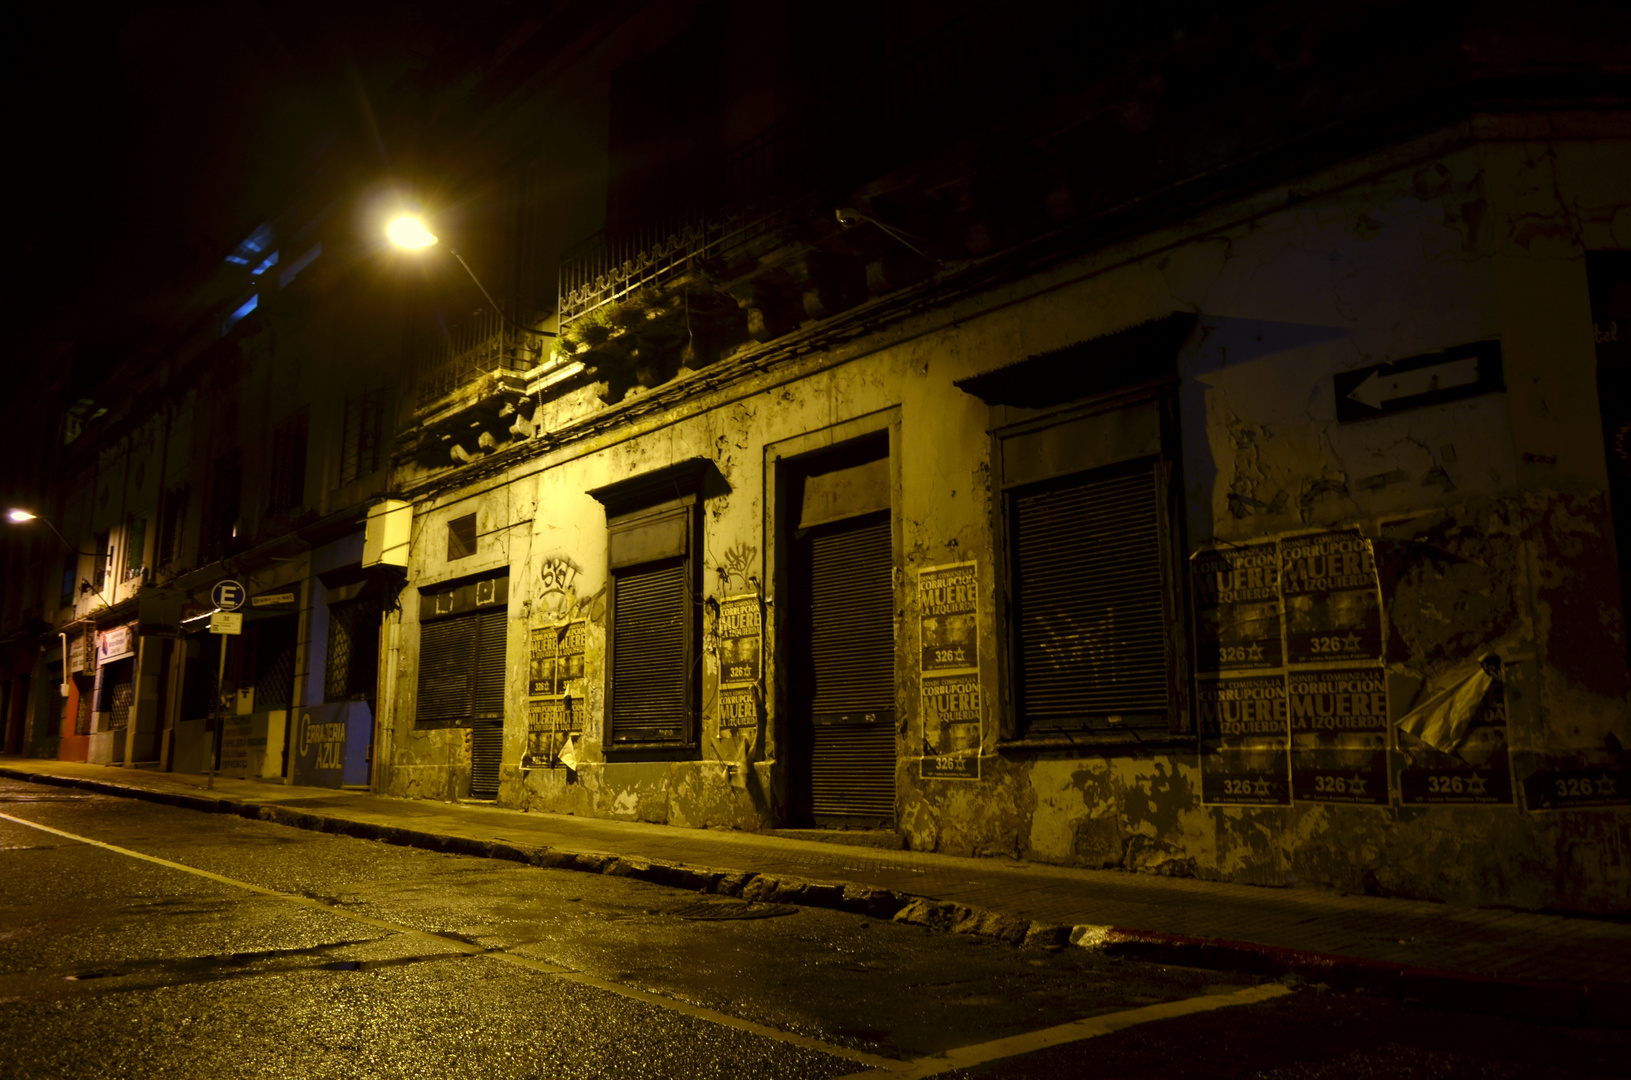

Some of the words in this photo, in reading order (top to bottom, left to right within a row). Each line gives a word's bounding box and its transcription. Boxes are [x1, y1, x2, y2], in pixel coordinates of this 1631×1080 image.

[1284, 551, 1374, 581] MUERE
[1194, 565, 1277, 594] MUERE
[1285, 581, 1300, 593] LA
[1304, 573, 1377, 592] IZQUIERDA
[220, 585, 238, 605] E
[921, 584, 976, 607] MUERE
[1214, 587, 1279, 604] IZQUIERDA
[921, 606, 930, 616] LA
[932, 601, 976, 616] IZQUIERDA
[720, 612, 761, 631] MUERE
[1310, 637, 1340, 653] 326
[935, 649, 954, 663] 326
[1219, 646, 1245, 662] 326
[730, 667, 743, 678] 326
[1290, 674, 1318, 683] DONDE
[1321, 672, 1365, 681] COMIENZA
[1369, 671, 1380, 679] LA
[923, 692, 980, 713] MUERE
[1291, 692, 1386, 718] MUERE
[555, 711, 584, 724] MURE
[938, 710, 980, 723] ZQUIERDA
[1200, 699, 1287, 723] MUERE
[1201, 723, 1217, 735] LA
[1219, 721, 1288, 735] IZQUIERDA
[1291, 716, 1307, 729] LA
[1311, 716, 1387, 730] IZQUIERDA
[315, 742, 342, 769] AZUL
[935, 757, 954, 770] 326
[1223, 779, 1251, 794] 326
[1315, 776, 1345, 792] 326
[1428, 776, 1463, 793] 326
[1555, 778, 1593, 797] 326
